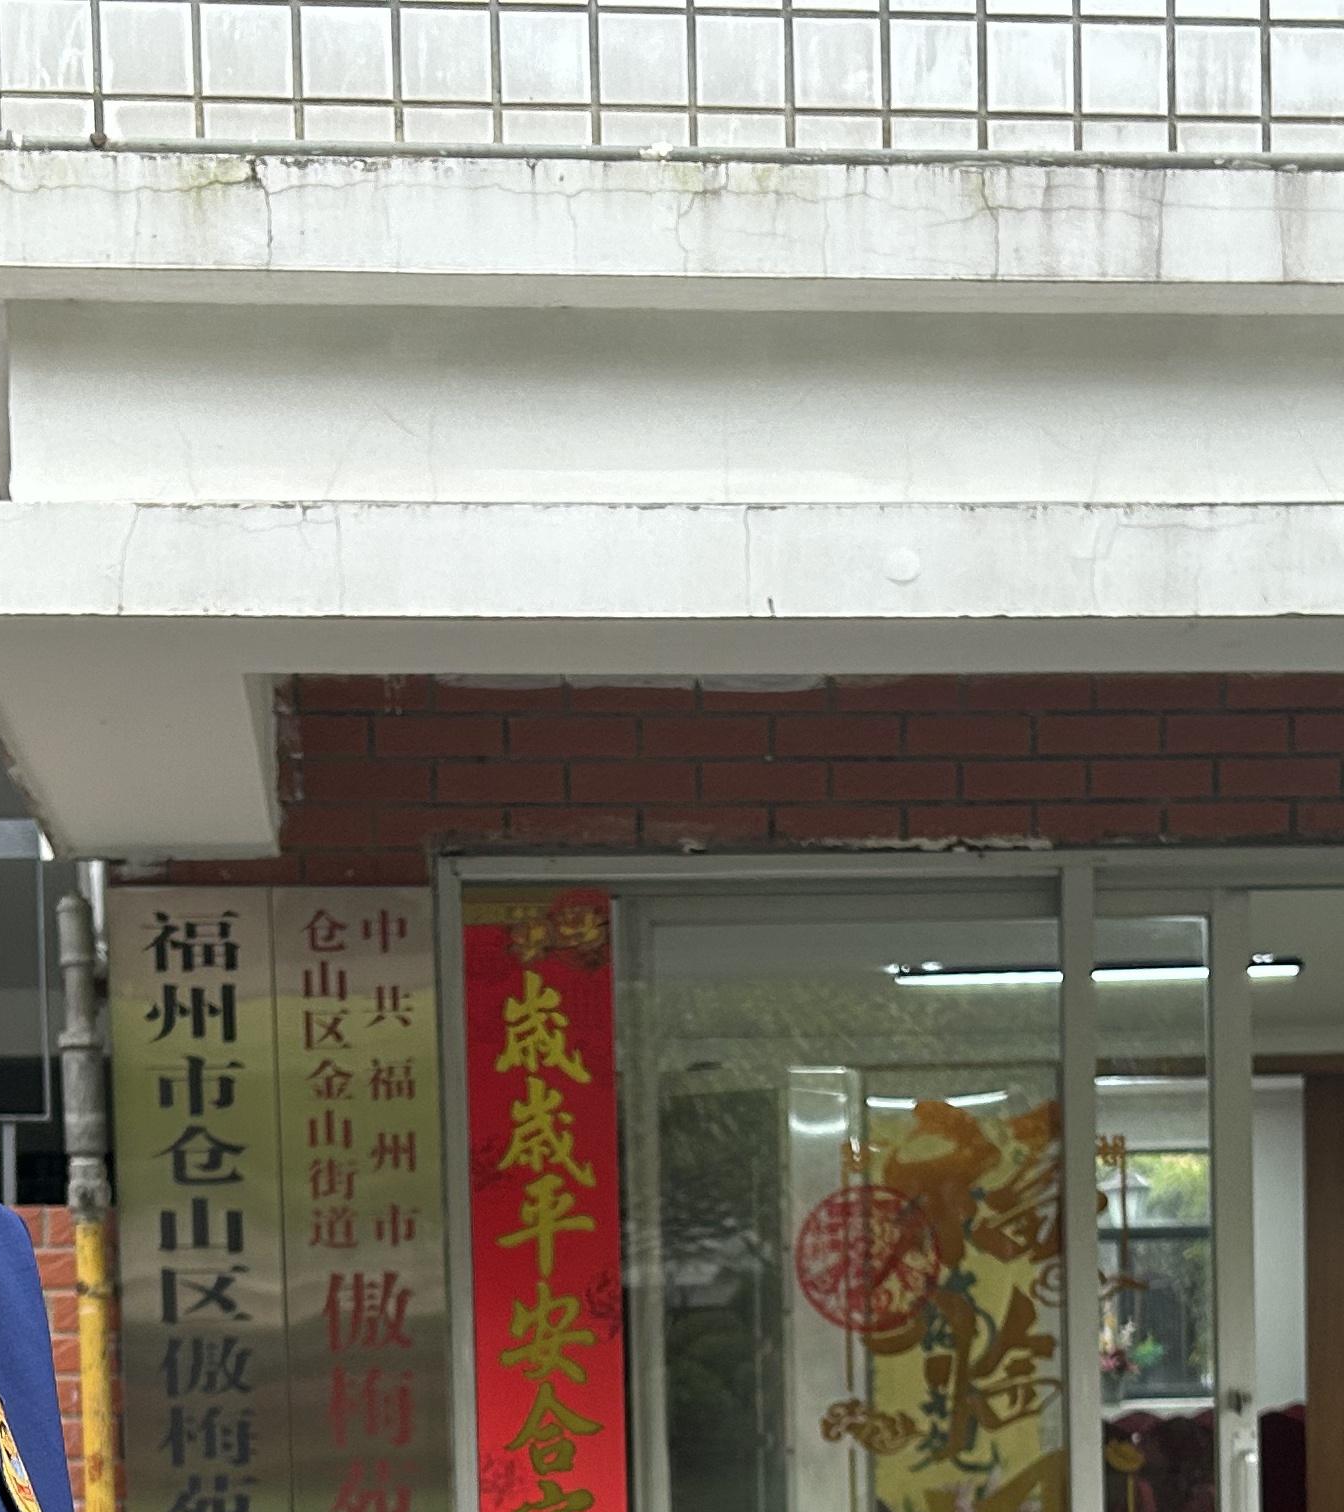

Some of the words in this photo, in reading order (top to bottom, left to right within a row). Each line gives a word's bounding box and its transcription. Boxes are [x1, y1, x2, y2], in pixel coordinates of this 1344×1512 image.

[301, 908, 358, 1250] 仓山区金山街道
[361, 908, 422, 1250] 中共福州市
